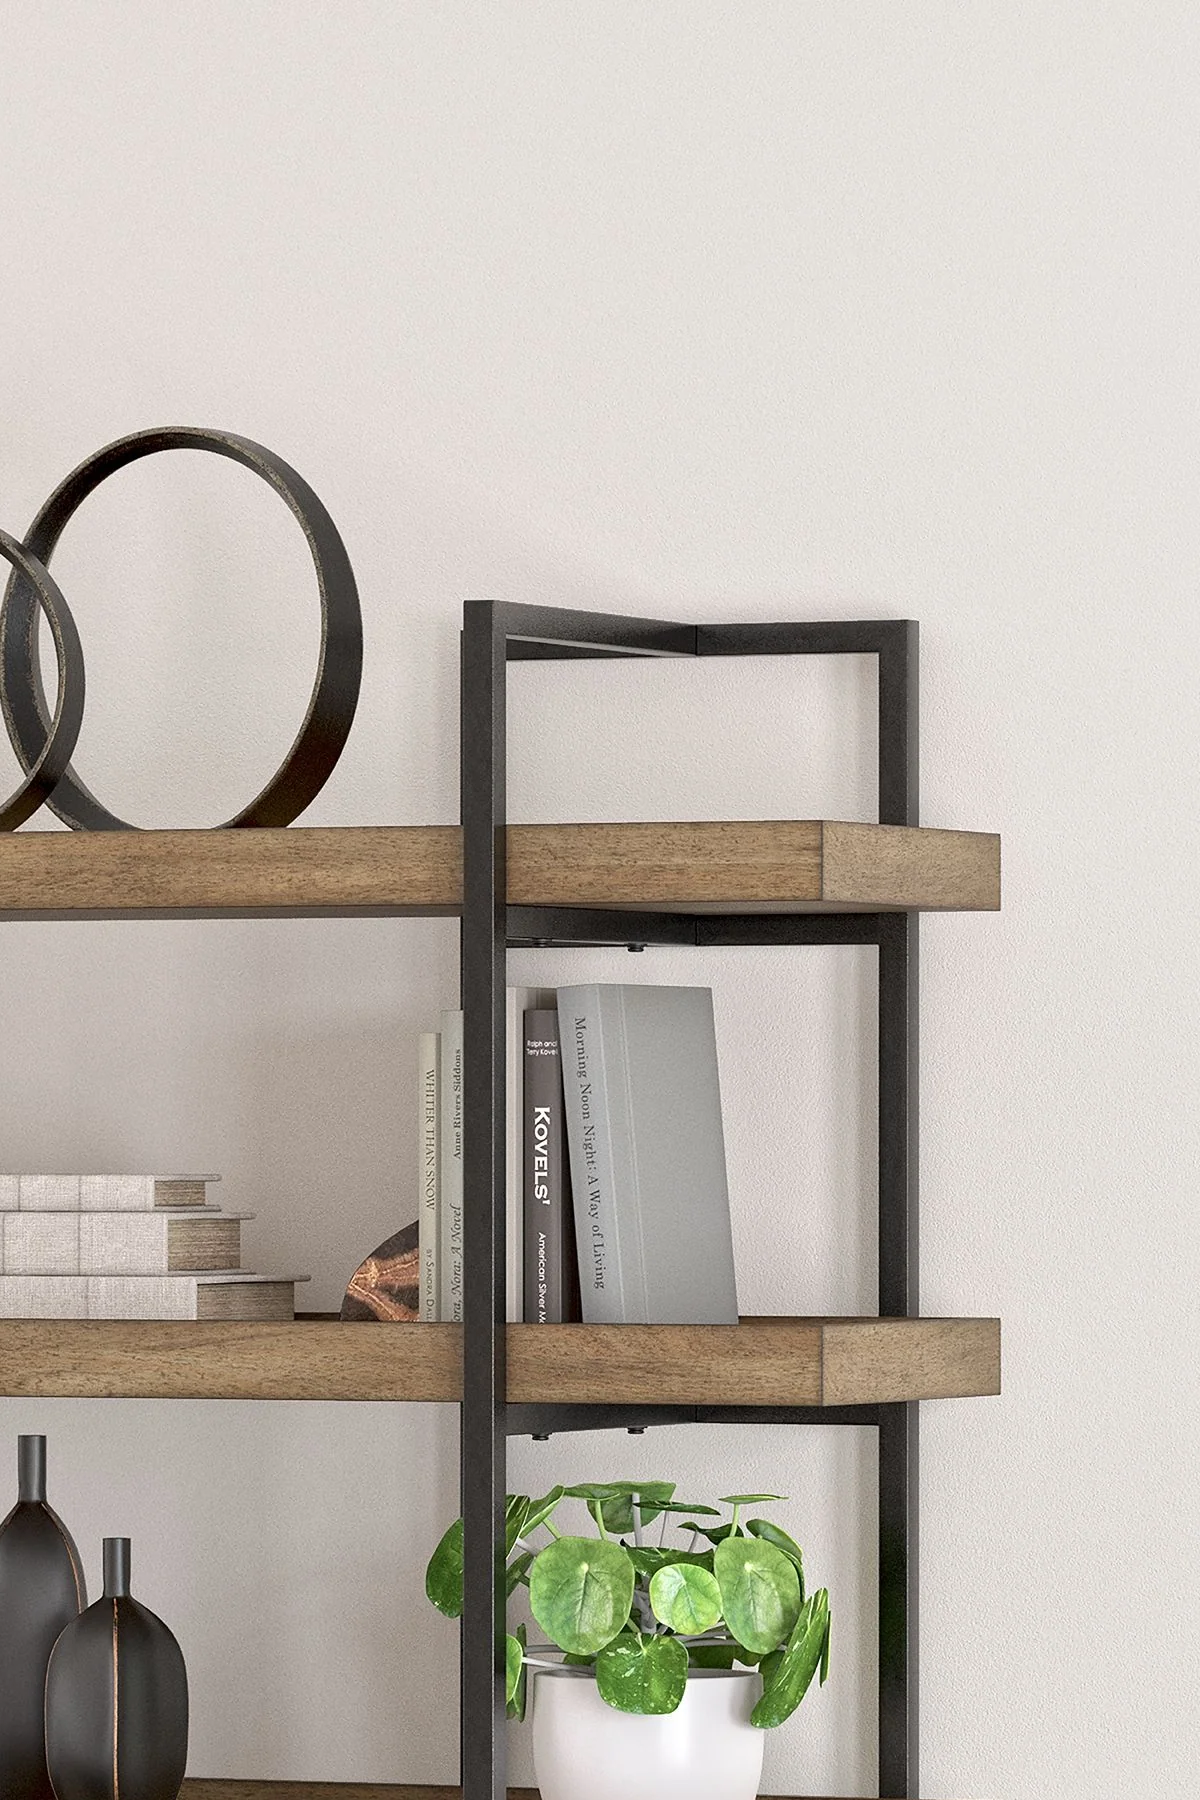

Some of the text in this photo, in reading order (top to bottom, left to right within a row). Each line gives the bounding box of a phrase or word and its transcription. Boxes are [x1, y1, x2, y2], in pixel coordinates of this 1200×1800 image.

[425, 1070, 434, 1210] WHITER THAN SNOW
[453, 1049, 461, 1159] Anne Rivers Siddons
[535, 1107, 550, 1205] KOVELS'
[575, 1018, 606, 1289] Morning Noon Night: A Way of Living
[450, 1203, 463, 1321] ora, Nora: A Novel
[538, 1232, 547, 1281] American
[538, 1283, 547, 1308] Silver
